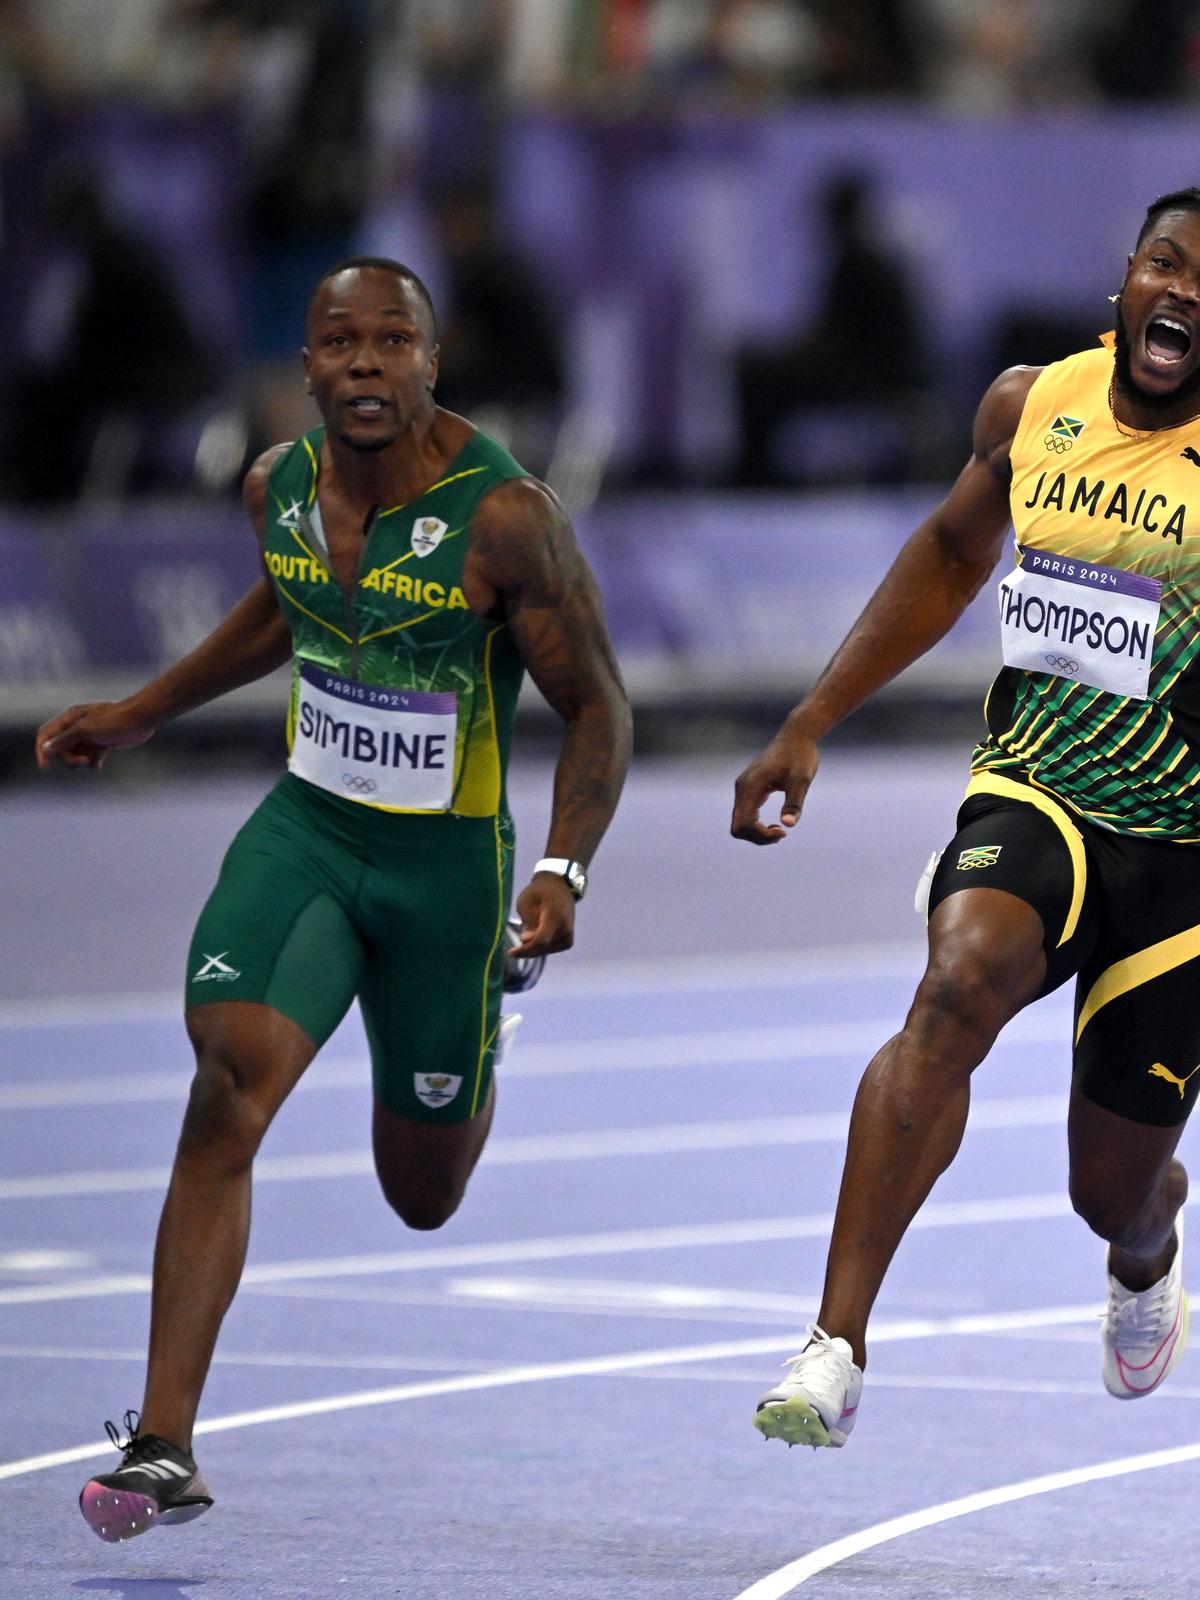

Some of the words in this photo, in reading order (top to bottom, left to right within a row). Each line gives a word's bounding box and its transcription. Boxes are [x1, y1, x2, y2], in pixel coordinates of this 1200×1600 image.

[1025, 472, 1187, 545] JAMAICA
[360, 567, 470, 610] AFRICA
[1033, 556, 1076, 576] PARIS
[1079, 568, 1118, 586] 2024
[1001, 583, 1151, 660] THOMPSON
[326, 678, 365, 699] PARIS
[369, 691, 409, 706] 2024
[300, 701, 447, 769] SIMBINE
